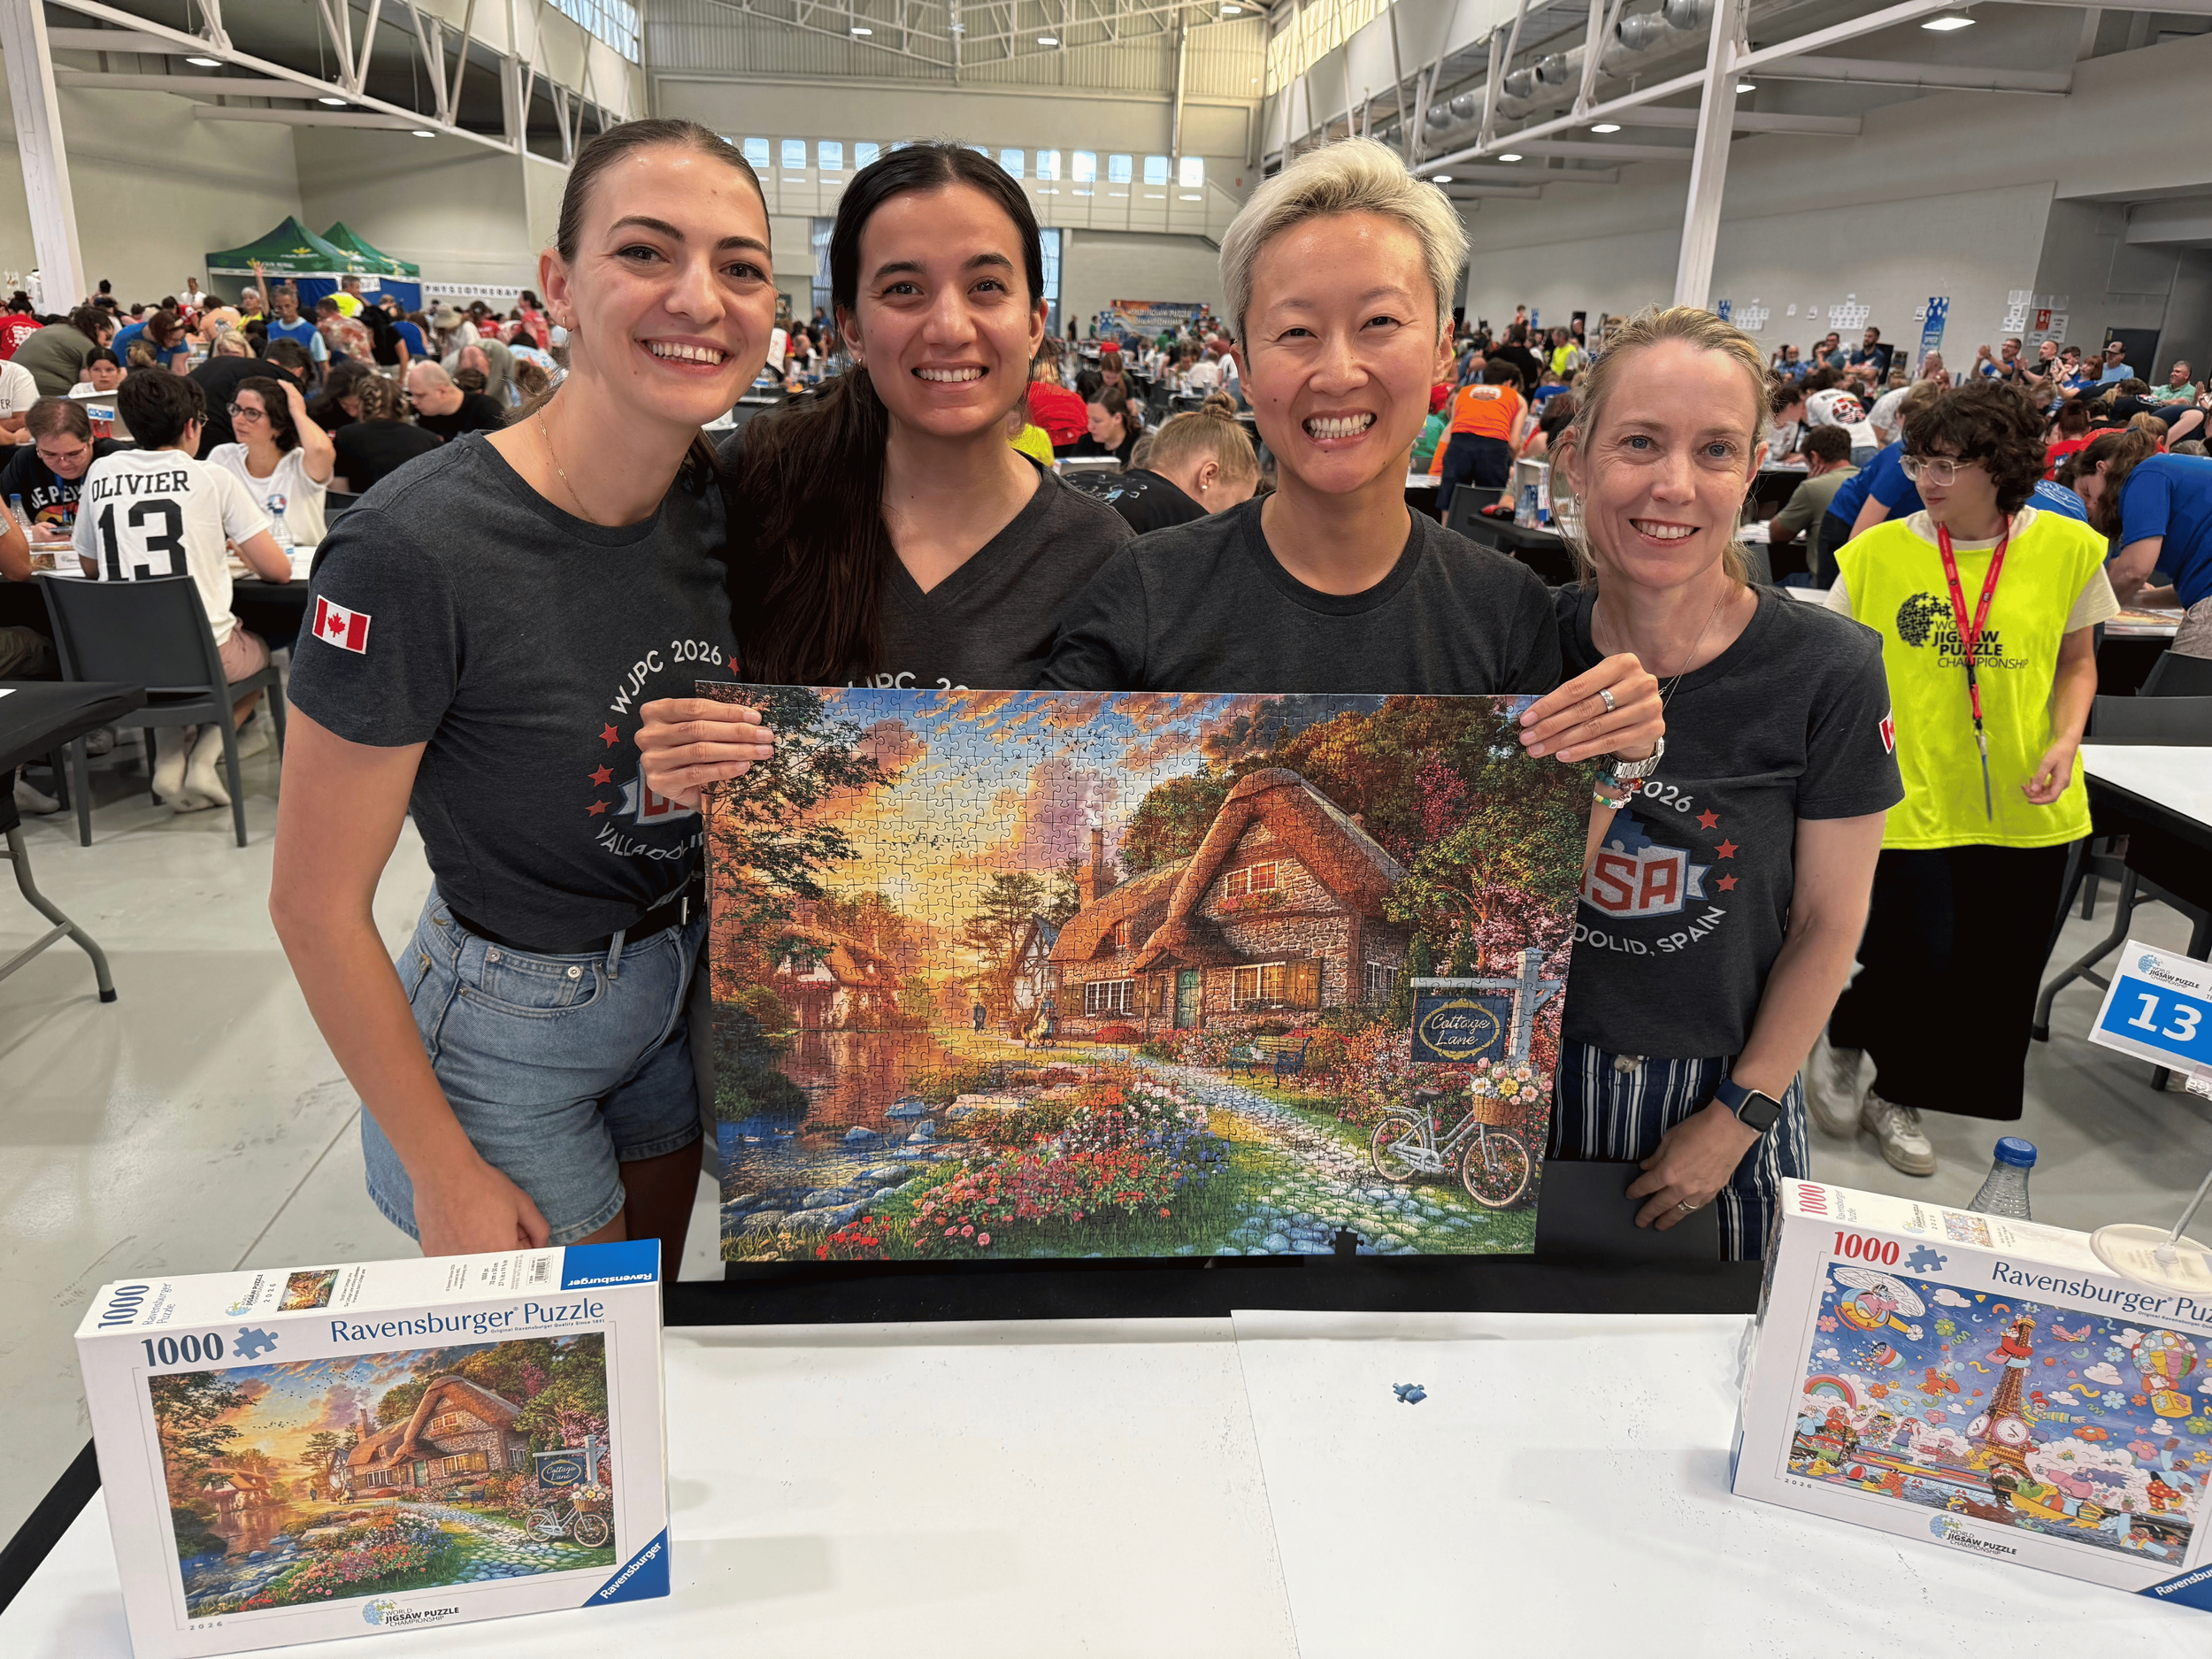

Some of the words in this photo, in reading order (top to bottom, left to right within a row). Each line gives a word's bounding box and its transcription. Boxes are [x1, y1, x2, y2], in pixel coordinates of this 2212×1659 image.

[425, 284, 520, 297] PHYSIOTHERAP
[92, 470, 190, 503] OLIVIER
[31, 487, 49, 510] JE
[98, 498, 189, 581] 13
[1938, 657, 2029, 670] CHAPIONSHIP
[611, 649, 664, 715] WJPC
[671, 639, 723, 666] 2026
[1580, 852, 1678, 911] SA
[1656, 905, 1727, 953] SPAIN
[2148, 969, 2176, 981] JIGSAW
[2175, 977, 2200, 989] PUZZLE
[1431, 1012, 1491, 1035] Cottage
[2127, 993, 2203, 1042] 13
[1434, 1029, 1479, 1047] Lane
[1798, 1183, 1828, 1216] 1000
[1847, 1207, 1858, 1224] Puzzle
[1833, 1231, 1900, 1266] 1000
[567, 1272, 653, 1287] Ravensburger
[142, 1282, 173, 1325] Ravensburger
[263, 1283, 277, 1303] 2026
[98, 1285, 150, 1329] 1000
[156, 1303, 176, 1325] Puzzle
[524, 1297, 604, 1325] Puzzle
[2138, 1310, 2161, 1319] Original
[514, 1323, 553, 1332] Ravensburger
[141, 1332, 225, 1367] 1000
[546, 1465, 577, 1475] Cottage
[1784, 1479, 1813, 1489] 2026
[1947, 1532, 1982, 1546] JIGSAW
[1983, 1541, 2017, 1555] PUZZLE
[1949, 1528, 1975, 1539] WORLD
[1949, 1540, 2001, 1555] CHAMPIONSHIP
[599, 1542, 662, 1600] Ravensburger
[2154, 1568, 2212, 1596] Ravensbu
[385, 1608, 413, 1617] WORLD
[385, 1612, 422, 1624] JIGSAW
[424, 1607, 460, 1617] PUZZLE
[389, 1615, 444, 1627] CHAMPIONSHIP
[188, 1621, 223, 1632] 2026
